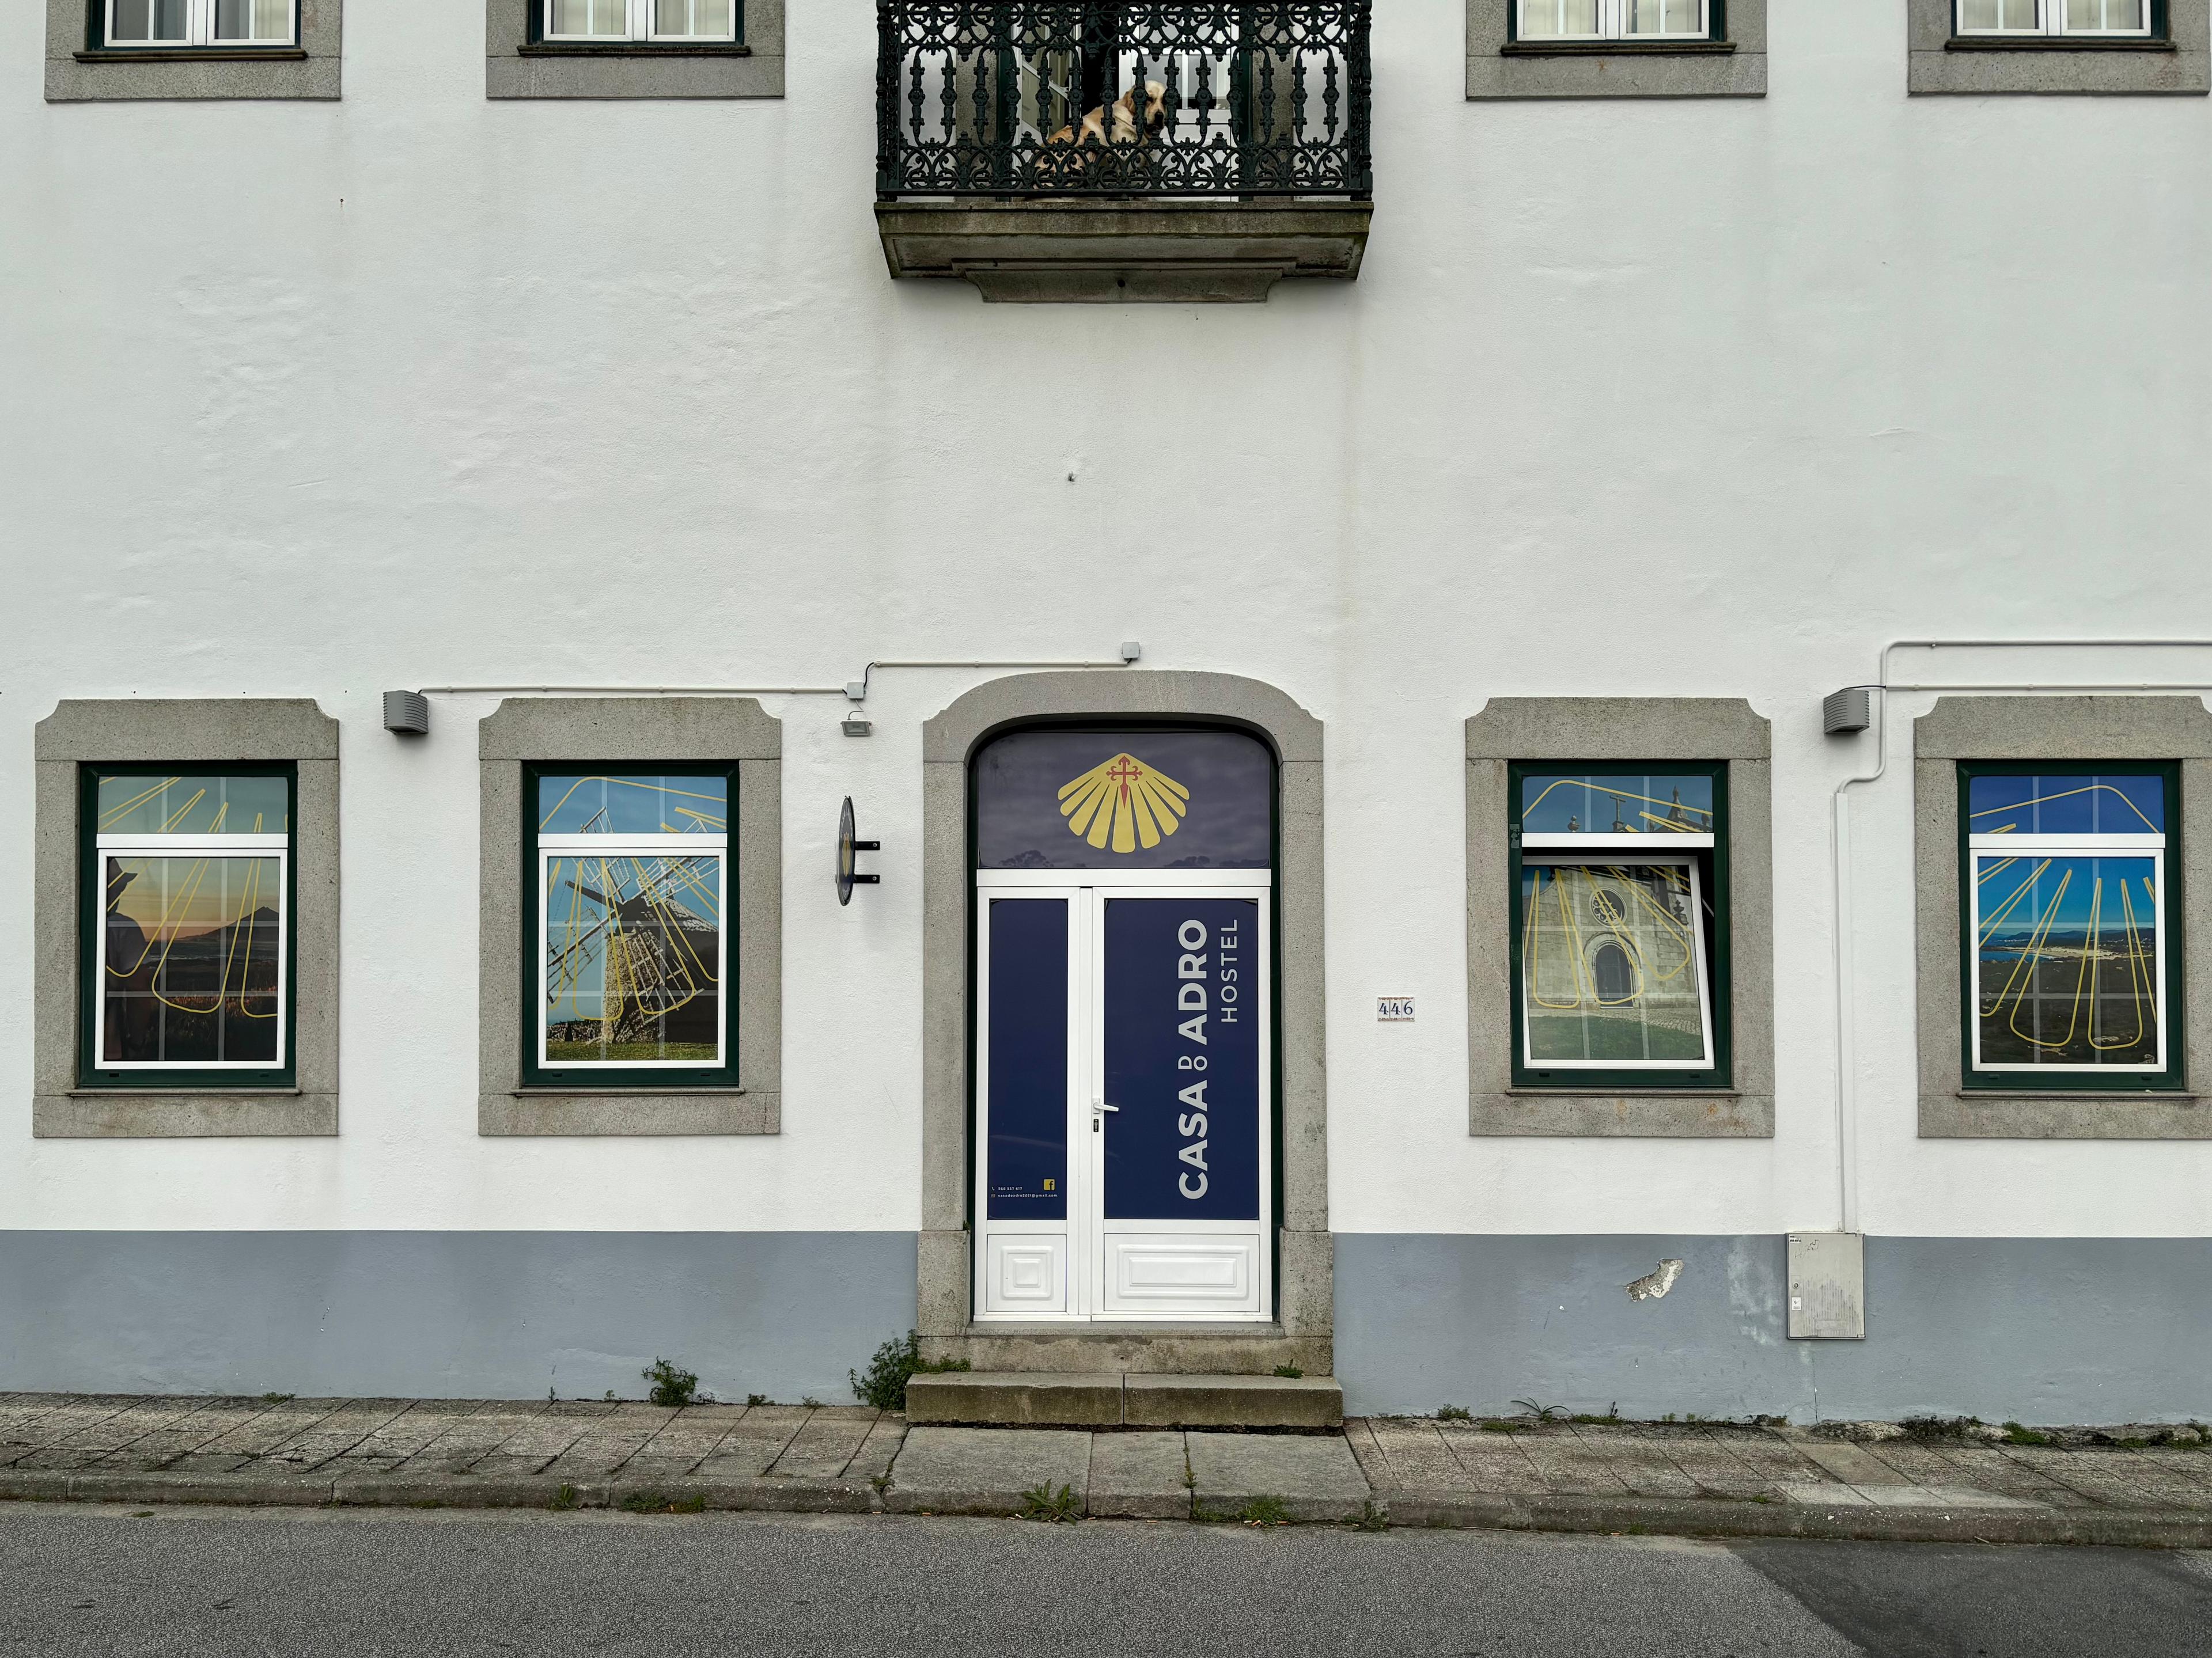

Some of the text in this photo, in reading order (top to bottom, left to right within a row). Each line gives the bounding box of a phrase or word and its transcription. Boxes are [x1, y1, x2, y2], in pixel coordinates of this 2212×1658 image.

[1221, 920, 1237, 1022] HOSTEL
[1378, 1000, 1413, 1015] 446
[1178, 920, 1208, 1200] CASA DO ADRO
